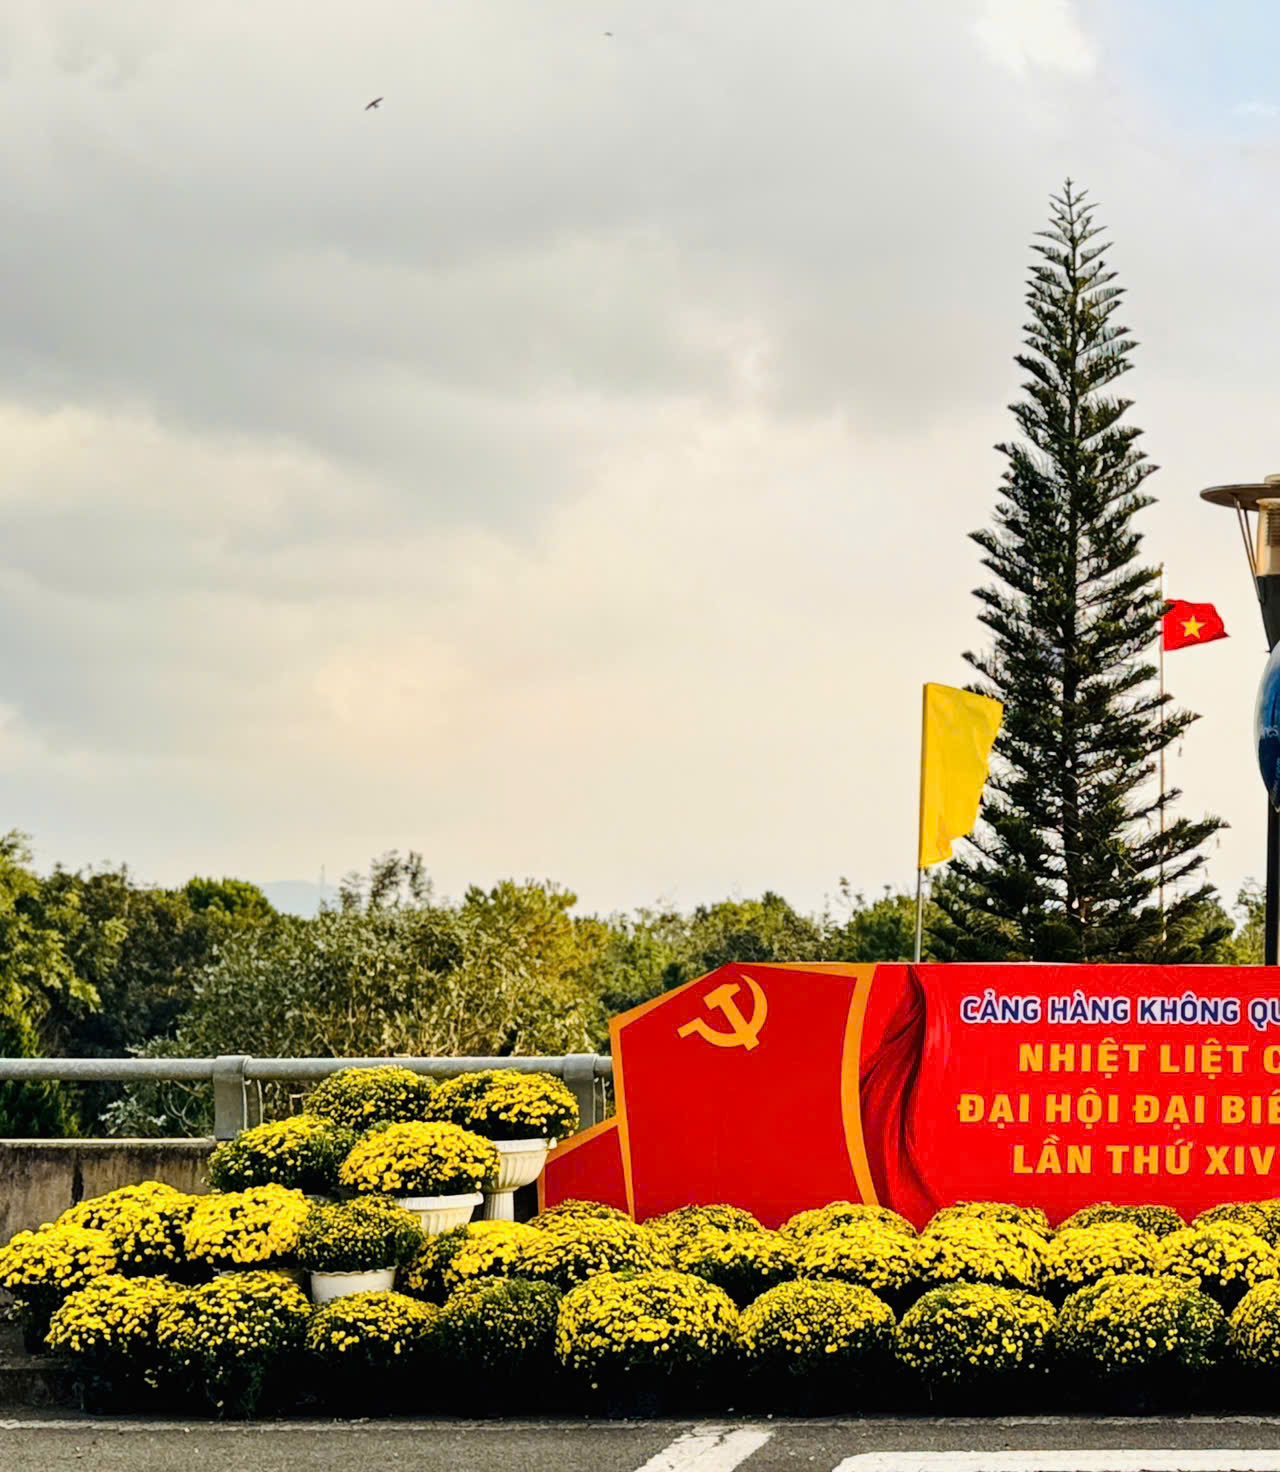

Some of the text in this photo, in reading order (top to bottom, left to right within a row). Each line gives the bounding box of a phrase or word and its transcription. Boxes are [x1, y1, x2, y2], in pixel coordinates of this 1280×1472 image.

[962, 991, 1039, 1022] CẢNG
[1050, 992, 1128, 1022] HÀNG
[1140, 993, 1238, 1023] KHÔNG
[1020, 1037, 1146, 1078] NHIỆT
[1160, 1038, 1249, 1079] LIỆT
[957, 1094, 1029, 1130] ĐẠI
[1046, 1087, 1118, 1130] HỘI
[1133, 1095, 1204, 1131] ĐẠI
[1014, 1134, 1091, 1173] LẦN
[1106, 1139, 1193, 1174] THỨ
[1205, 1146, 1275, 1175] XIV
